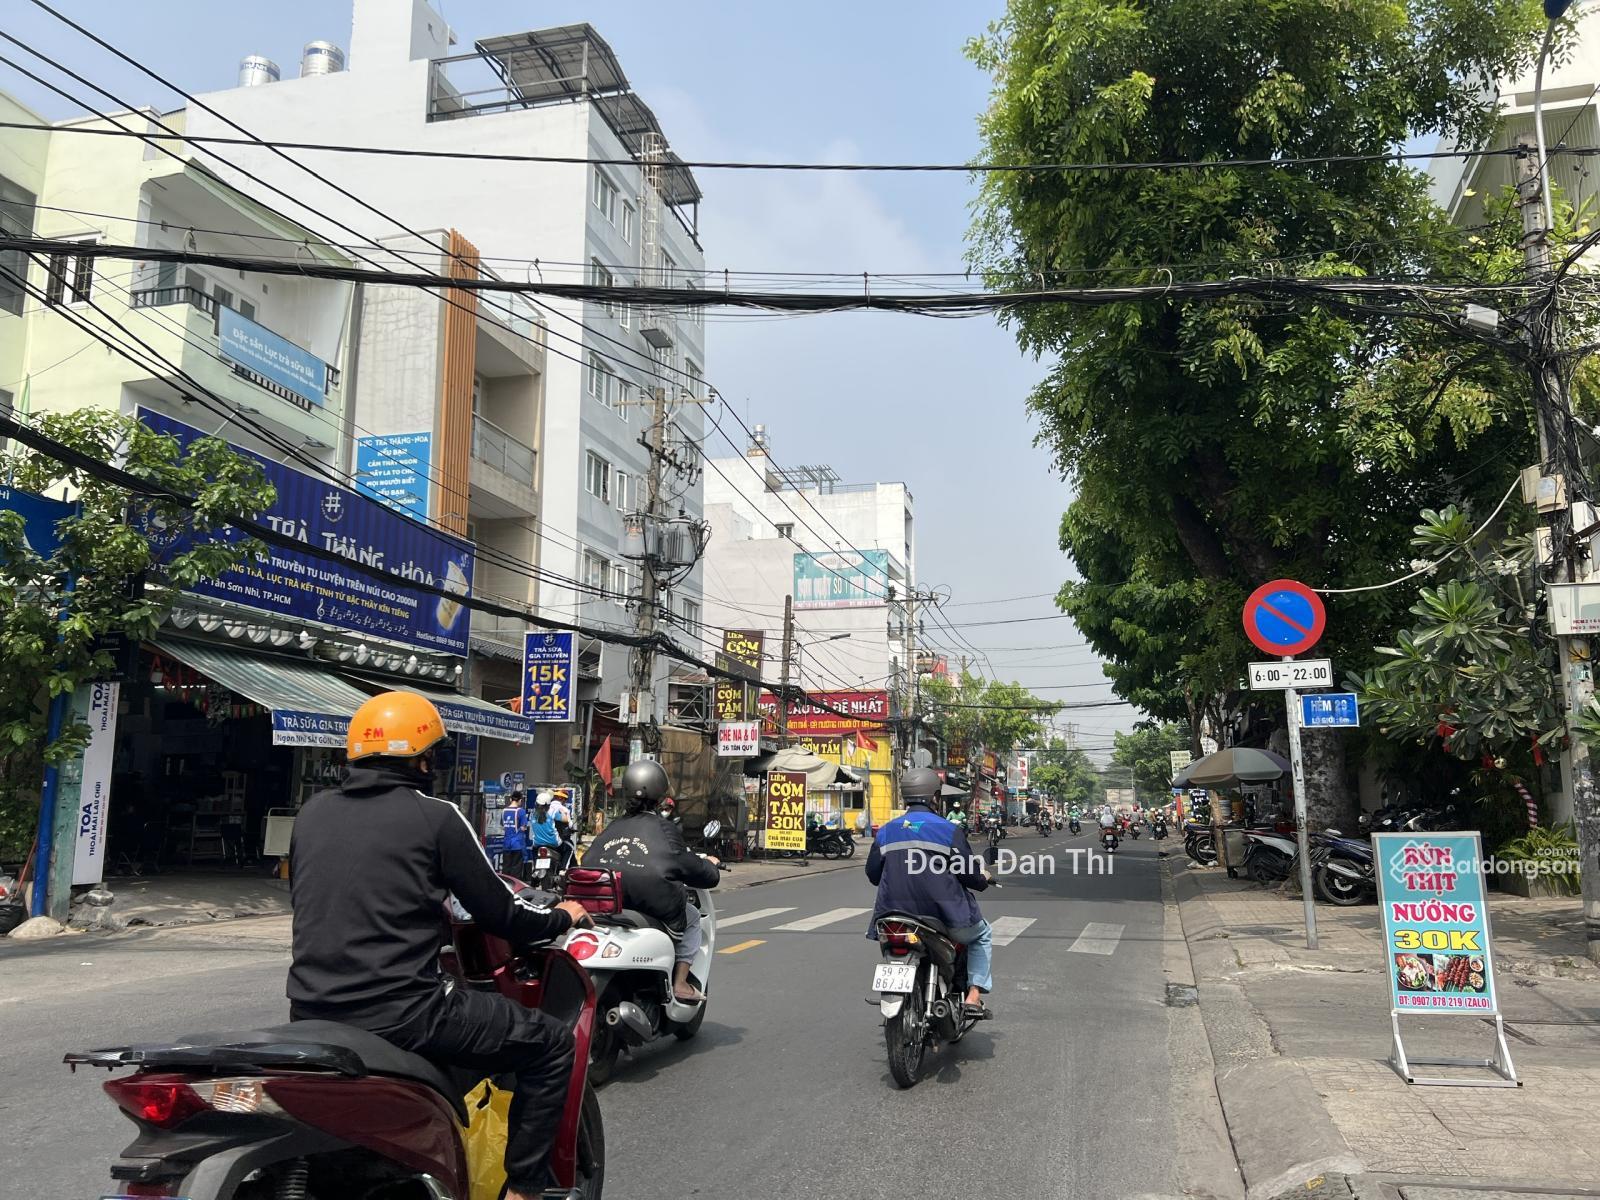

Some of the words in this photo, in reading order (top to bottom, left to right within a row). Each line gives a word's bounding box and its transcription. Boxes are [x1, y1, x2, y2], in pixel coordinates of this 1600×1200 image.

[267, 516, 308, 544] TRÀ
[200, 574, 208, 584] P.
[227, 582, 243, 594] Sơn
[244, 586, 261, 600] Nhì,
[262, 590, 291, 605] TP.HCM
[272, 555, 306, 575] TRUYỀN
[306, 566, 318, 578] TU
[319, 570, 345, 587] LUYỆN
[346, 576, 365, 593] TRÊN
[366, 584, 380, 597] NÚI
[382, 590, 396, 602] CAO
[396, 592, 418, 608] 2000M
[266, 573, 282, 585] LỤC
[284, 576, 298, 588] TRÀ
[300, 581, 314, 593] KẾT
[316, 586, 334, 599] TINH
[335, 590, 346, 600] TỪ
[346, 593, 360, 606] BẬC
[361, 596, 378, 610] THẦY
[416, 630, 436, 642] Hotline:
[542, 651, 568, 659] TRUYỀN
[528, 665, 566, 682] 15k
[1256, 670, 1280, 682] 6:00
[1294, 668, 1326, 680] 22:00
[528, 695, 567, 710] 12k
[718, 688, 742, 700] CƠM
[717, 700, 742, 712] TẤM
[851, 696, 884, 714] NHẤT
[1310, 696, 1332, 712] HẺM
[282, 715, 299, 728] TRÀ
[300, 716, 316, 730] SỮA
[318, 720, 333, 730] GIA
[334, 721, 348, 732] TRU
[453, 710, 464, 719] GIA
[520, 722, 530, 730] CAO
[732, 728, 742, 741] NA
[744, 729, 748, 742] &
[822, 740, 840, 754] TẤM
[770, 780, 804, 797] CƠM
[770, 796, 804, 816] TẤM
[80, 803, 92, 837] TOA
[772, 816, 802, 830] 30K
[1404, 842, 1452, 866] BÚN
[1404, 872, 1457, 896] THỊT
[1392, 899, 1476, 924] NƯỚNG
[1394, 930, 1482, 951] 30K
[882, 966, 893, 976] 59
[1412, 996, 1430, 1006] 0907
[1432, 997, 1446, 1006] 878
[1449, 998, 1463, 1007] 219
[1464, 997, 1490, 1008] (ZALO)
